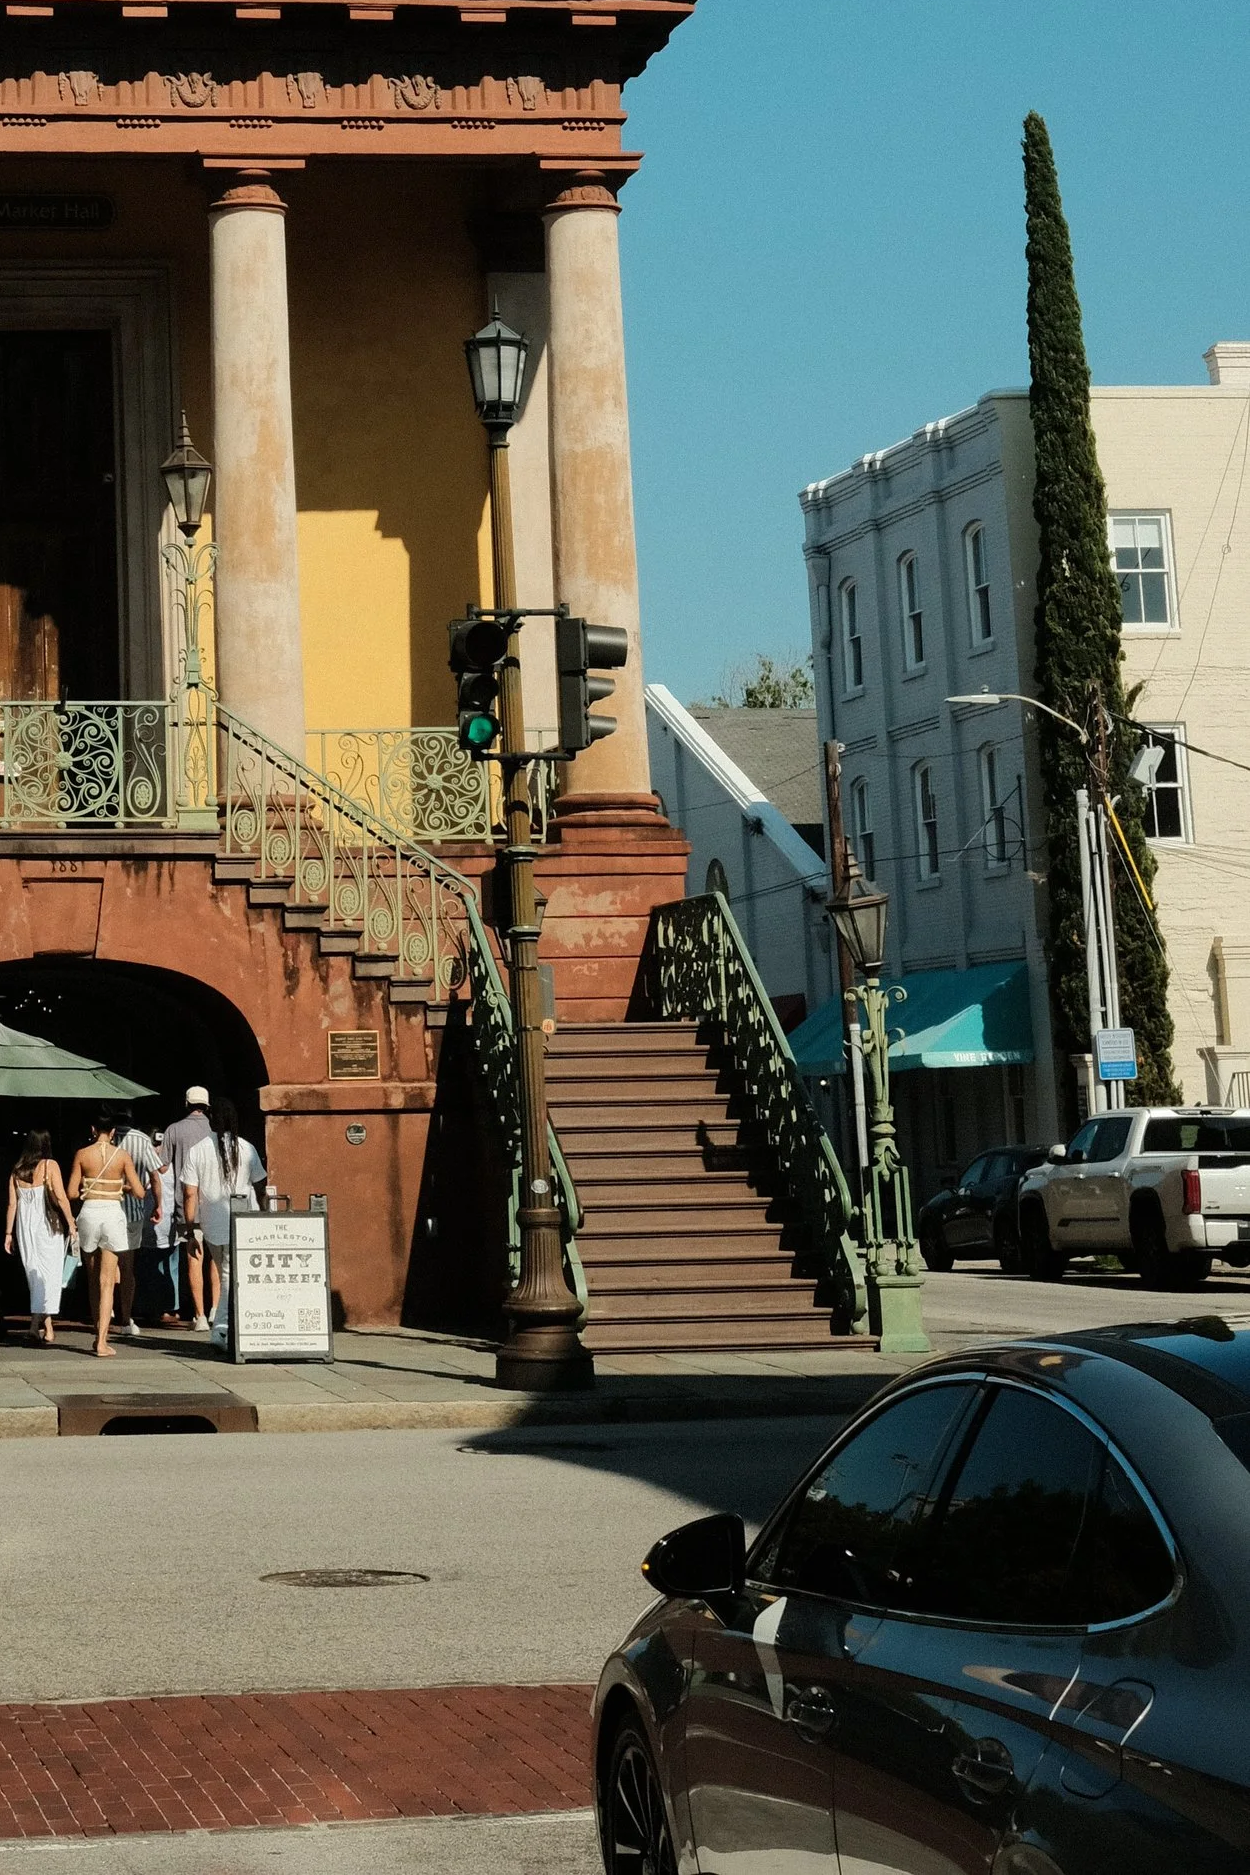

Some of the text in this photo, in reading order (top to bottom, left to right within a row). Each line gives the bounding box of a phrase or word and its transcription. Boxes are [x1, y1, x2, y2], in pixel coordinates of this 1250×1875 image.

[64, 202, 100, 218] Hall
[248, 1233, 315, 1243] CHARLESTON
[249, 1253, 312, 1268] CITY
[247, 1274, 321, 1284] MARKET
[244, 1309, 285, 1320] Open Daily
[253, 1322, 272, 1330] 9:30
